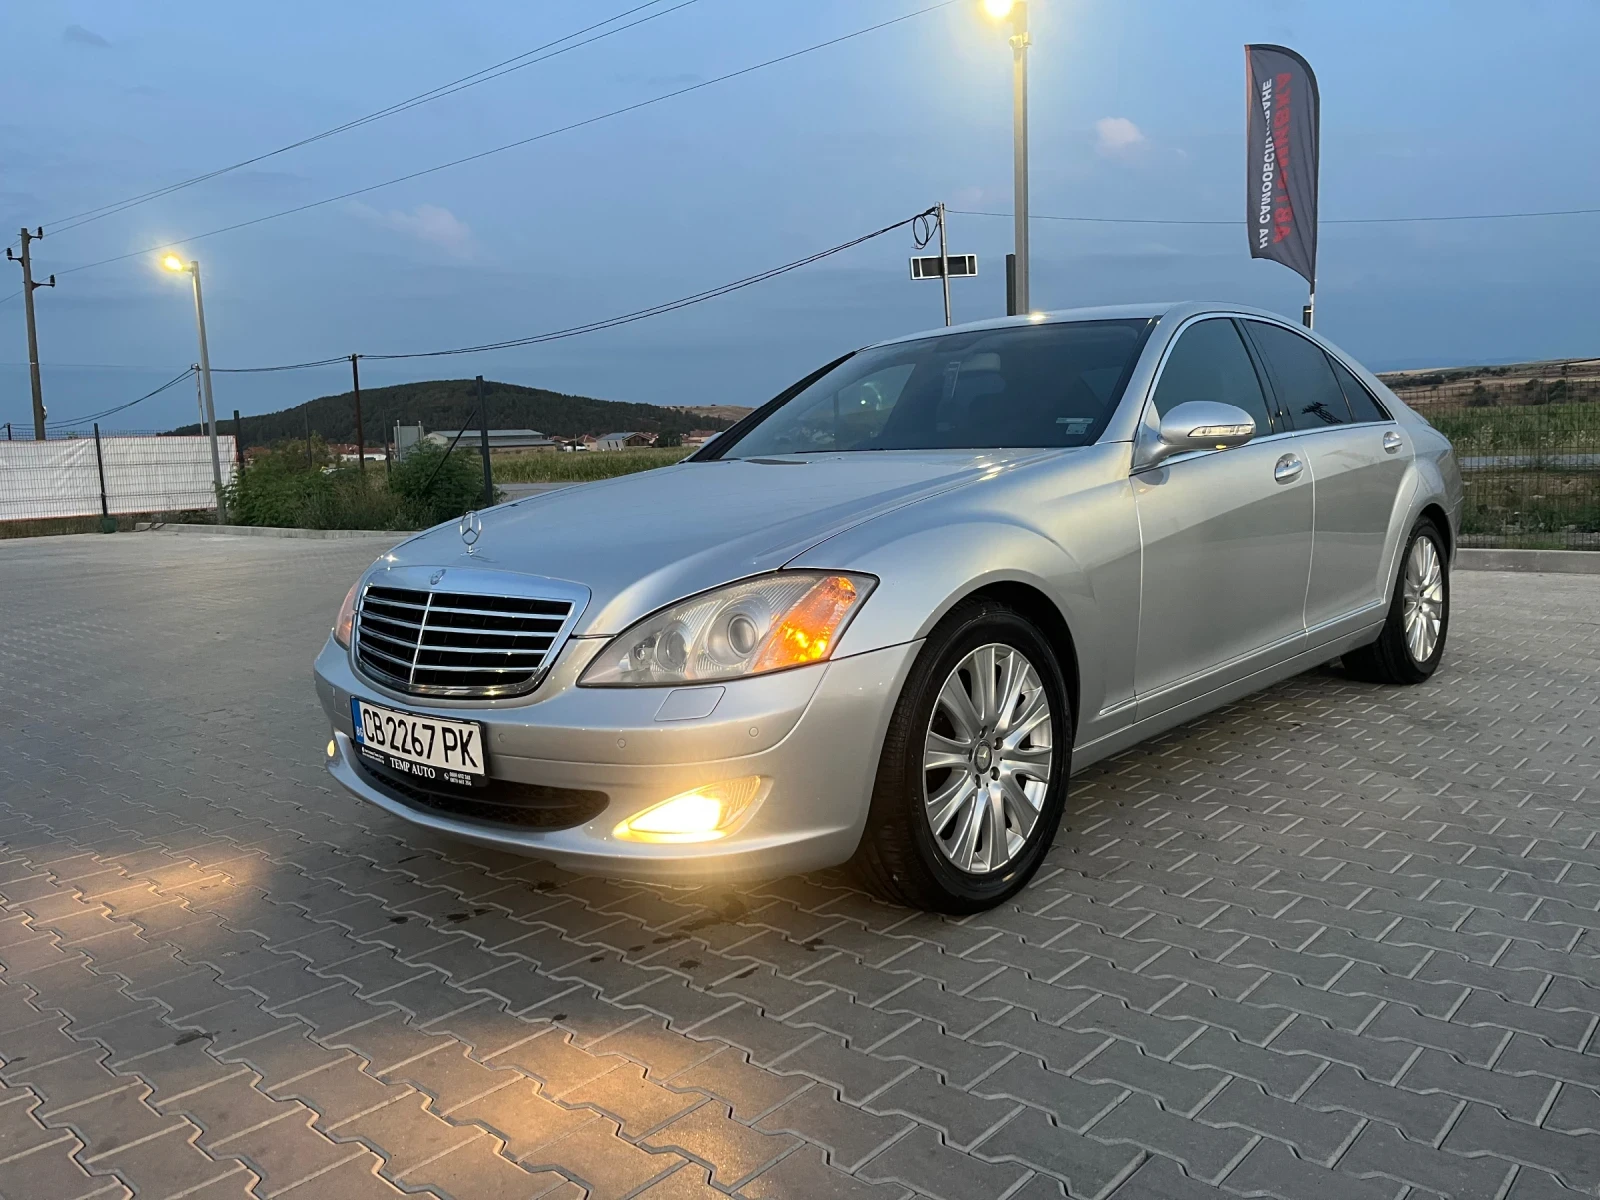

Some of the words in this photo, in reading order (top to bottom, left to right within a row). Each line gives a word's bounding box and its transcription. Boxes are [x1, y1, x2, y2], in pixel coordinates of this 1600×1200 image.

[356, 726, 364, 738] BG
[389, 757, 411, 773] TEMP
[411, 765, 436, 779] AUTO
